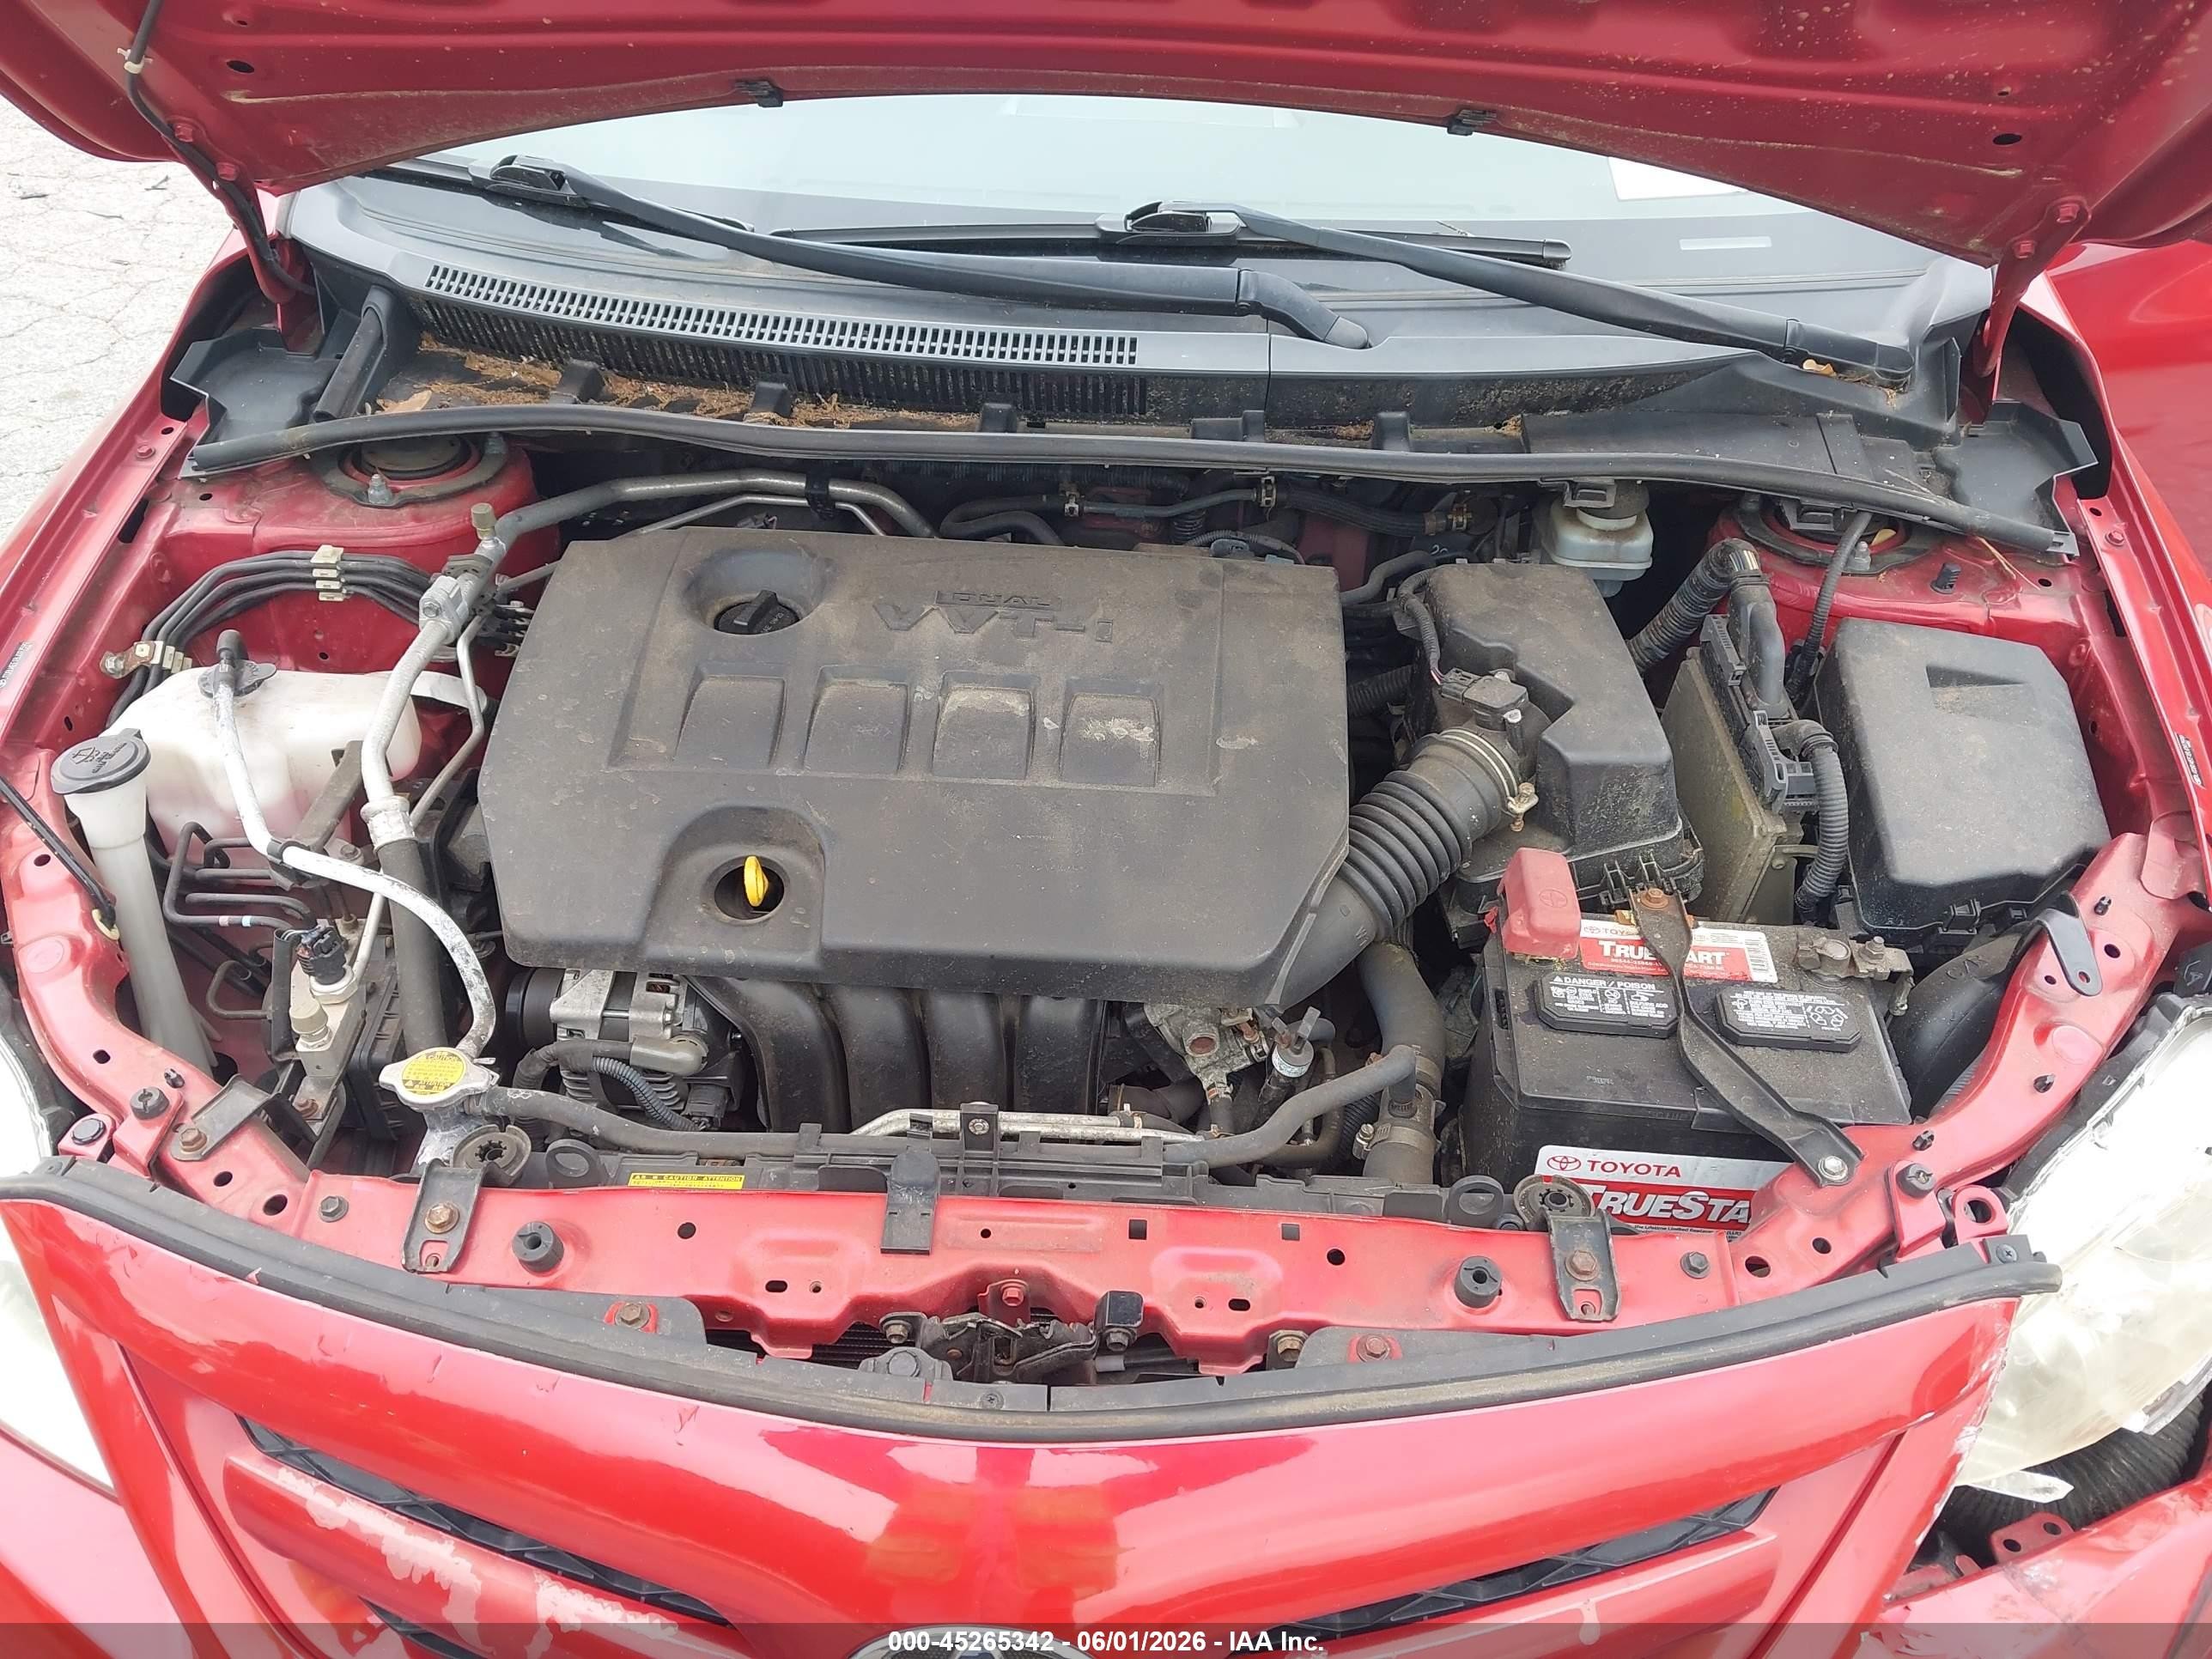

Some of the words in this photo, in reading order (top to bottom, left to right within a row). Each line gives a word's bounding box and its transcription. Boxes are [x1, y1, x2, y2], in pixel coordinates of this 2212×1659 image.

[1564, 976, 1607, 987] DANGER
[1617, 981, 1656, 990] POISON
[1589, 1159, 1681, 1178] TOYOTA
[1578, 1184, 1752, 1224] TRUESTA
